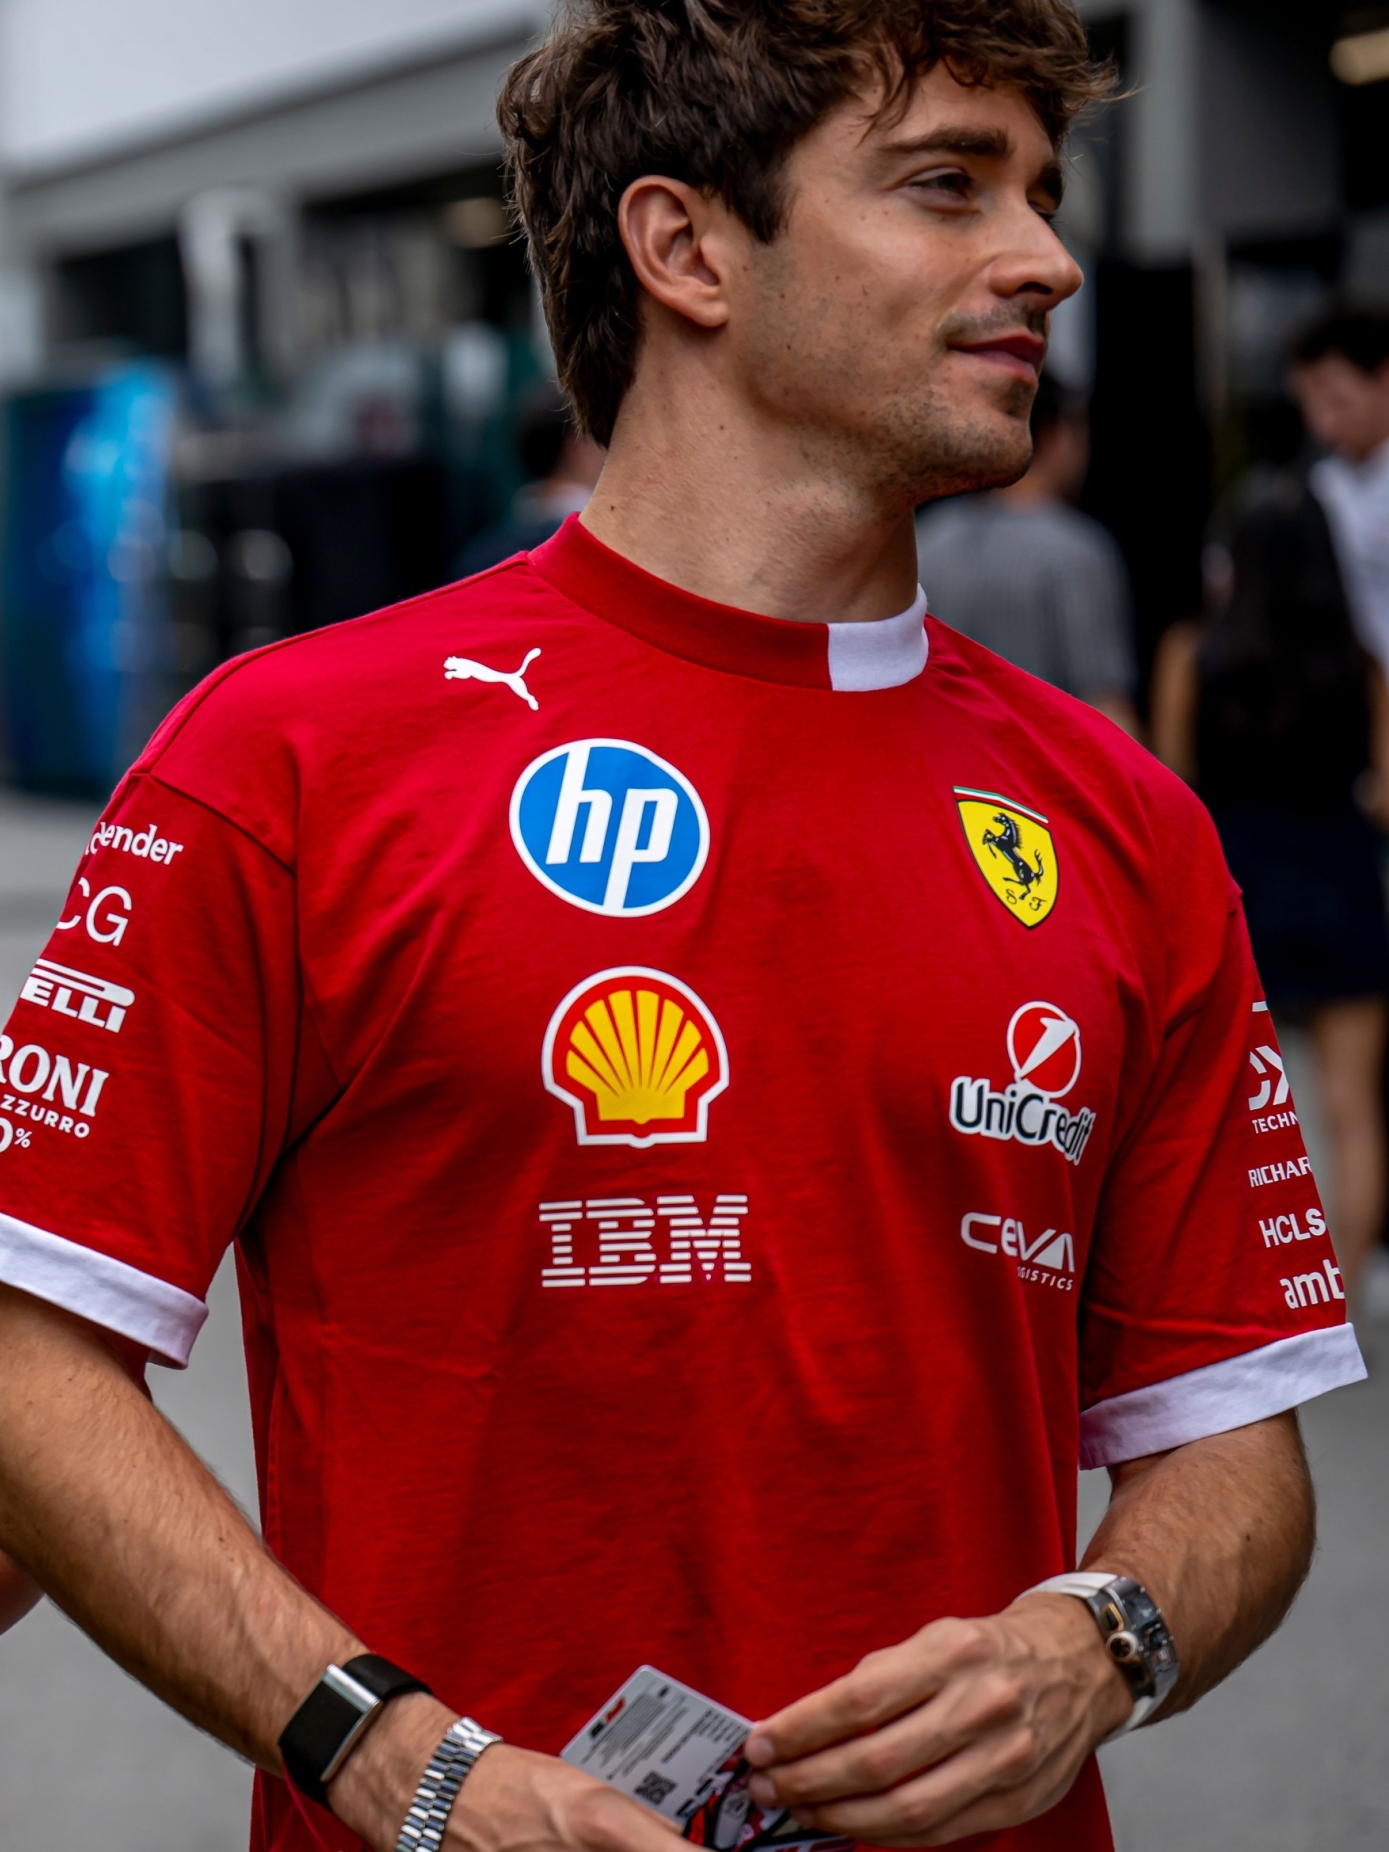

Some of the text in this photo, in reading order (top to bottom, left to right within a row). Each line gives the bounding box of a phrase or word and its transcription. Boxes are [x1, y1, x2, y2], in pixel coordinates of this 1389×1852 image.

[545, 745, 679, 911] hp
[953, 1079, 1093, 1162] UniCredit
[539, 1194, 752, 1288] IBM
